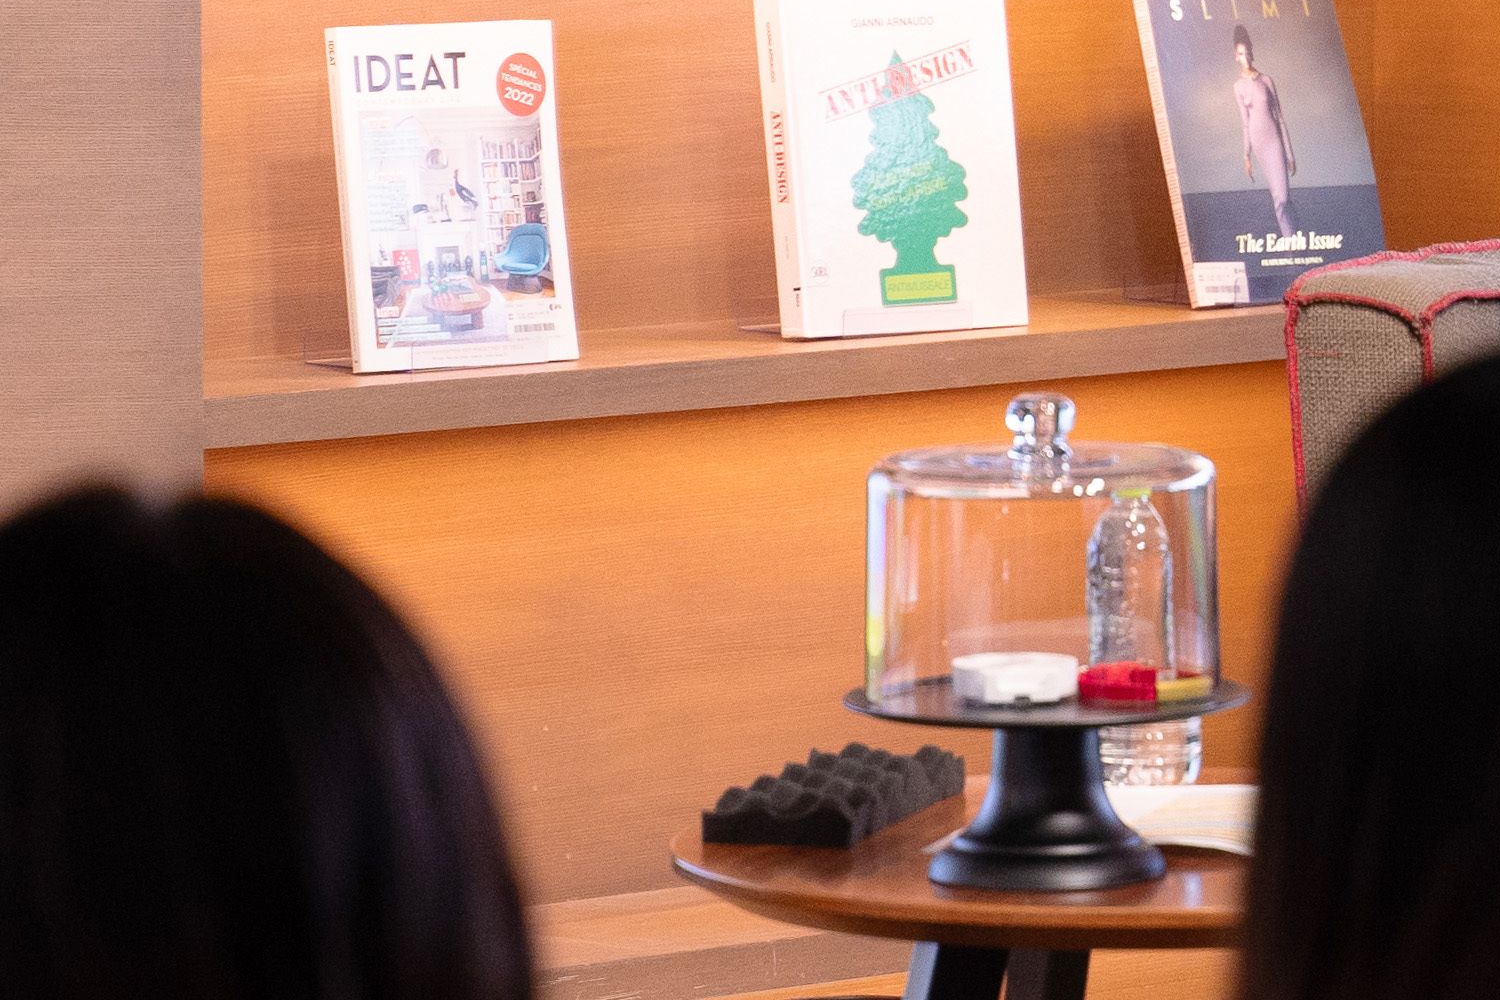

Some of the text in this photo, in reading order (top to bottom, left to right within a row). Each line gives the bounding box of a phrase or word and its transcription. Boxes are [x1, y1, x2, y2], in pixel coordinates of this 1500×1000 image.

[851, 15, 935, 28] GIANNI ARNAUDO
[328, 40, 336, 66] IDEAT
[354, 52, 465, 92] IDEAT
[508, 62, 538, 79] SPÉCIAL
[501, 72, 542, 92] TENDANCES
[504, 87, 535, 106] 2022
[1236, 230, 1343, 253] The Earth Issue
